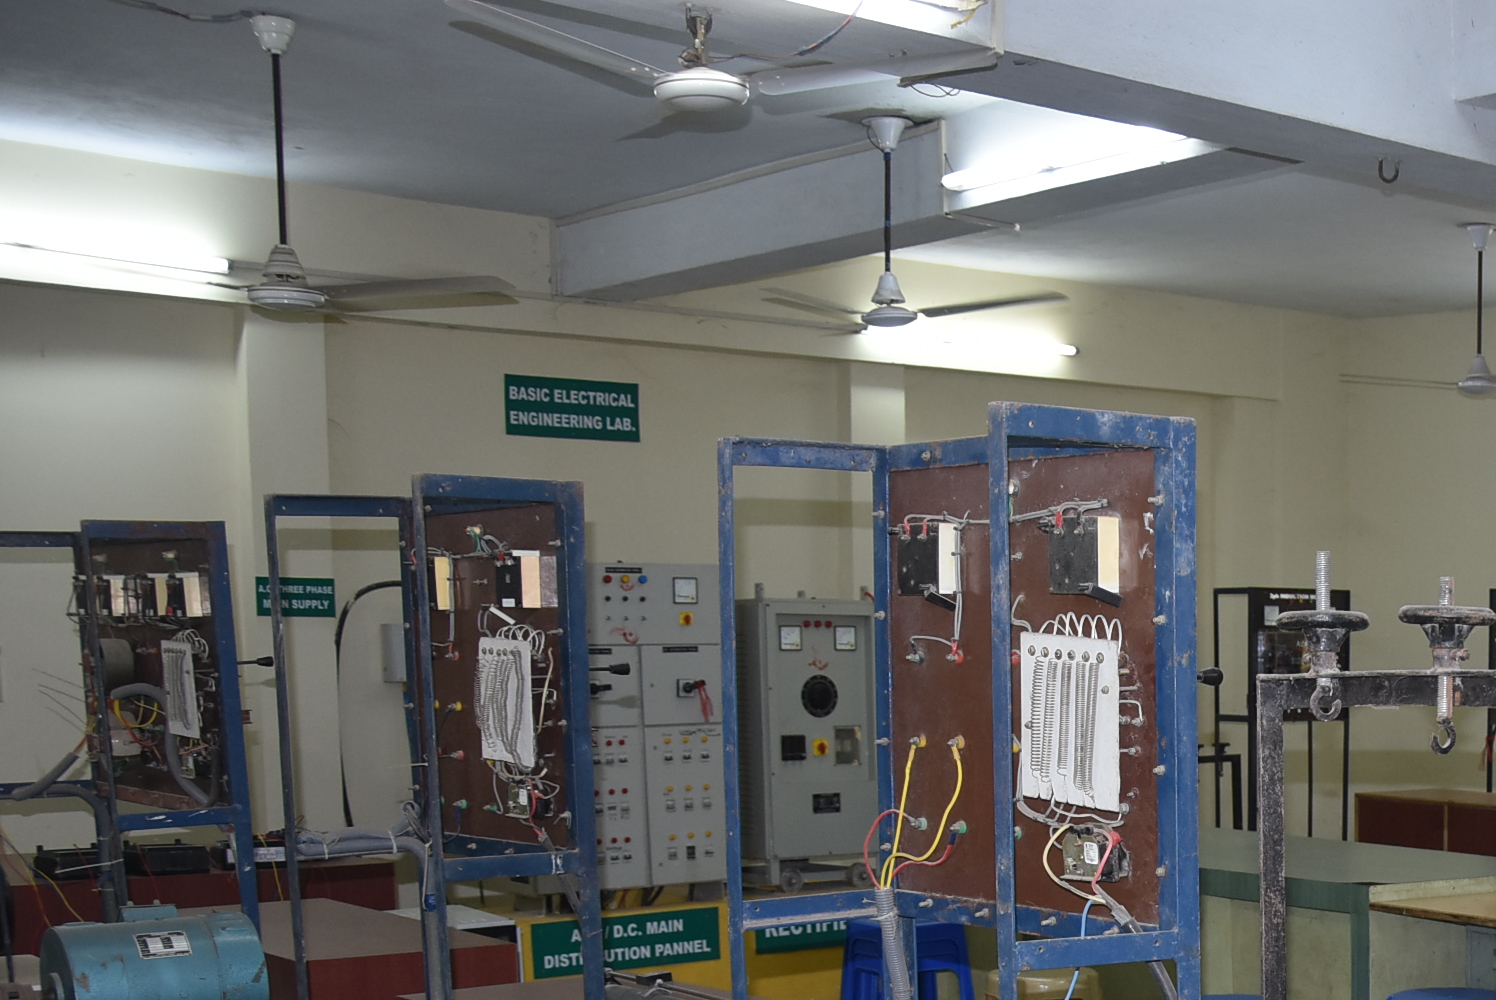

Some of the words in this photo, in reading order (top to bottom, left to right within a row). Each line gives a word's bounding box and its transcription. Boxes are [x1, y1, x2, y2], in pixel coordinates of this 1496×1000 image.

[509, 386, 550, 402] BASIC
[553, 389, 635, 408] ELECTRICAL
[509, 410, 602, 430] ENGINEERING
[606, 417, 636, 432] LAB.
[306, 585, 333, 594] PHASE
[263, 599, 289, 609] MN
[291, 599, 330, 609] SUPPLY
[613, 924, 642, 939] D.C.
[646, 919, 684, 935] MAIN
[765, 920, 847, 938] RECTIFIE
[544, 945, 651, 969] DISTUTION
[655, 939, 711, 957] PANNEL
